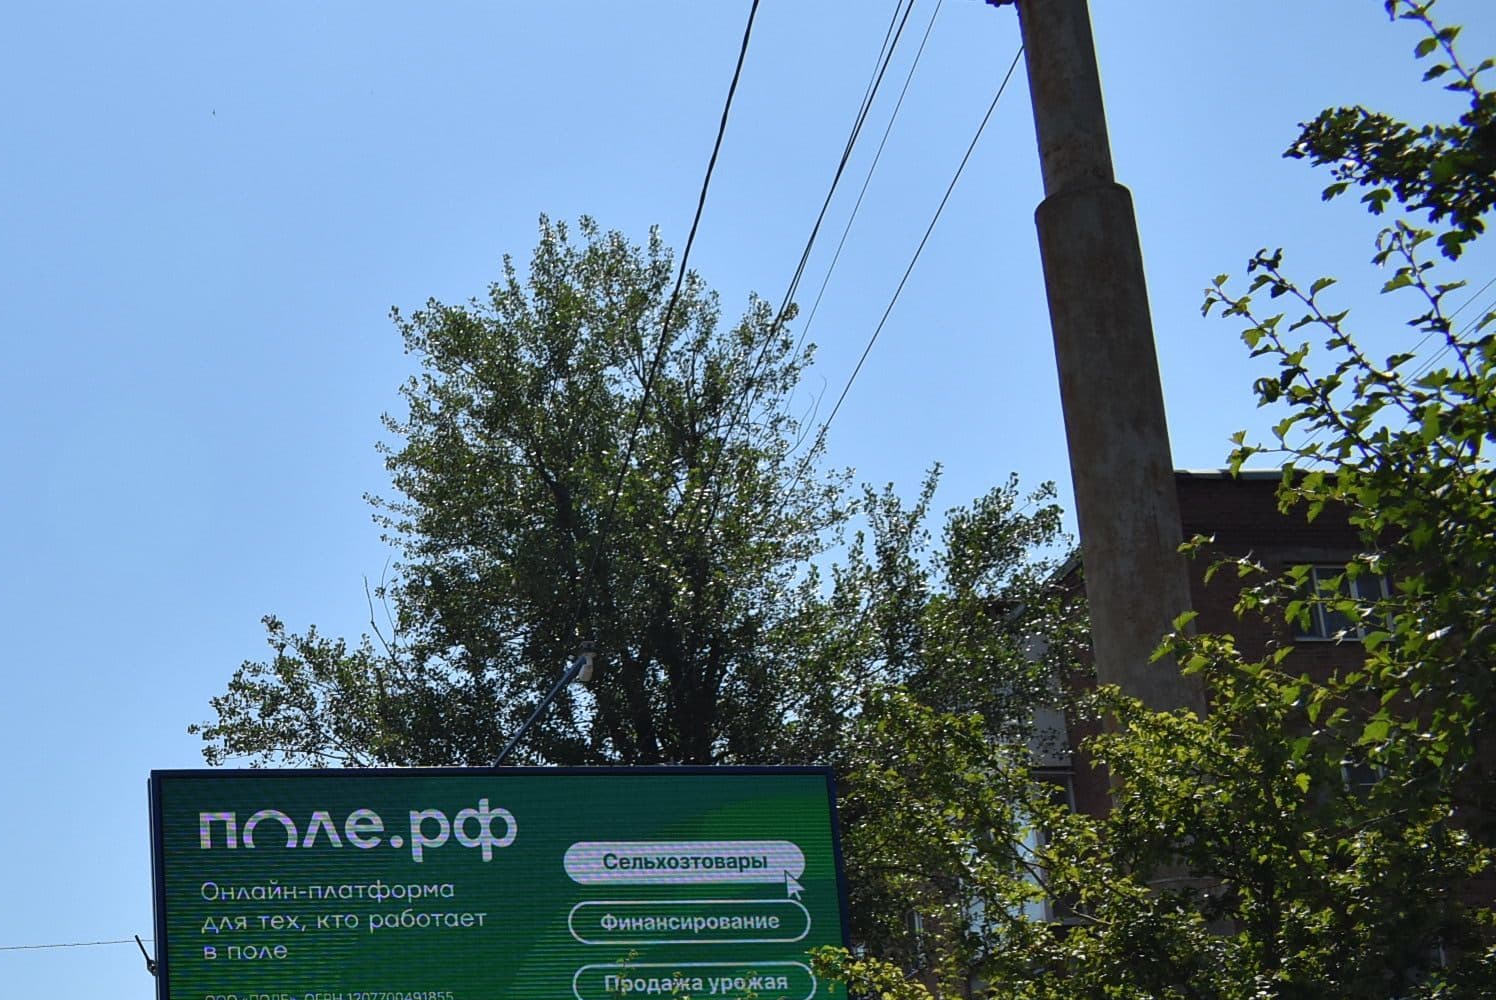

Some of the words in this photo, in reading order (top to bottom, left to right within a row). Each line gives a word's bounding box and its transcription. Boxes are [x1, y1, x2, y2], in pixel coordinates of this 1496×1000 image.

[199, 798, 518, 863] поле.рф
[603, 853, 768, 872] Сельхозтовары
[201, 879, 455, 903] Онлайн-платформа
[201, 917, 248, 933] для
[259, 914, 306, 932] тех,
[317, 914, 359, 929] кто
[369, 909, 488, 933] работает
[600, 913, 780, 933] Финансирование
[204, 946, 217, 959] в
[228, 944, 288, 960] поле
[604, 975, 703, 994] Продажа
[707, 975, 788, 994] урожая
